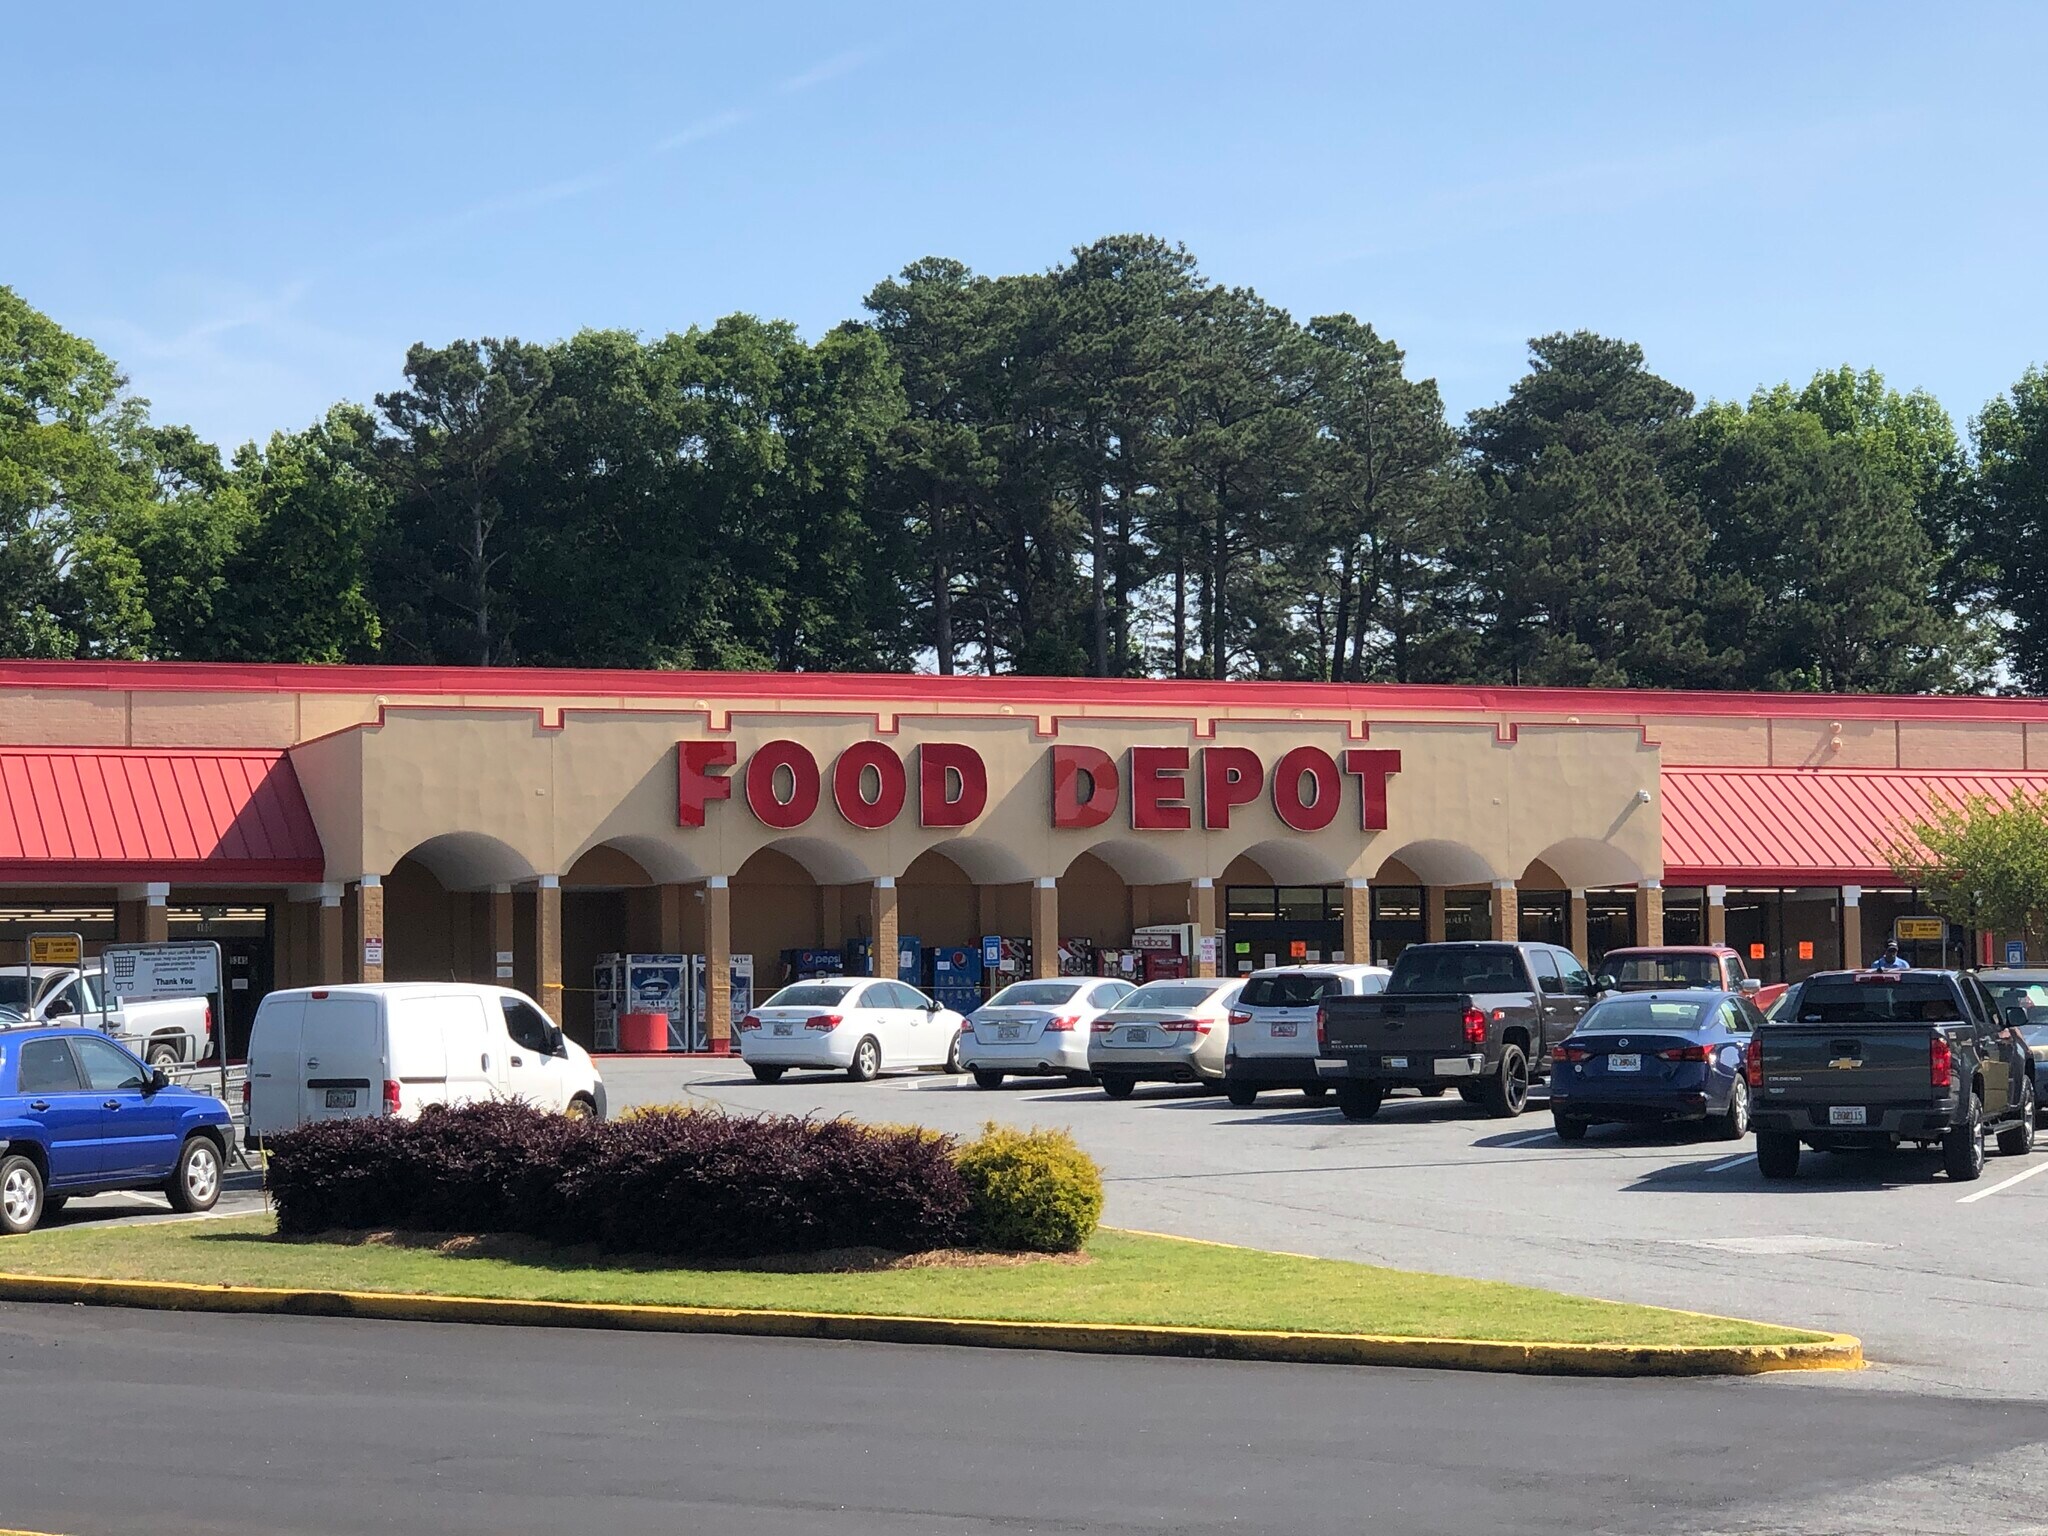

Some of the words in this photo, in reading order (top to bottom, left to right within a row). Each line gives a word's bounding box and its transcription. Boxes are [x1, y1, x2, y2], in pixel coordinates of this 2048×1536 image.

[676, 740, 987, 829] FOOD
[1051, 745, 1401, 832] DEPOT
[815, 954, 841, 965] pepsi
[155, 978, 178, 986] Thank
[180, 977, 193, 985] You
